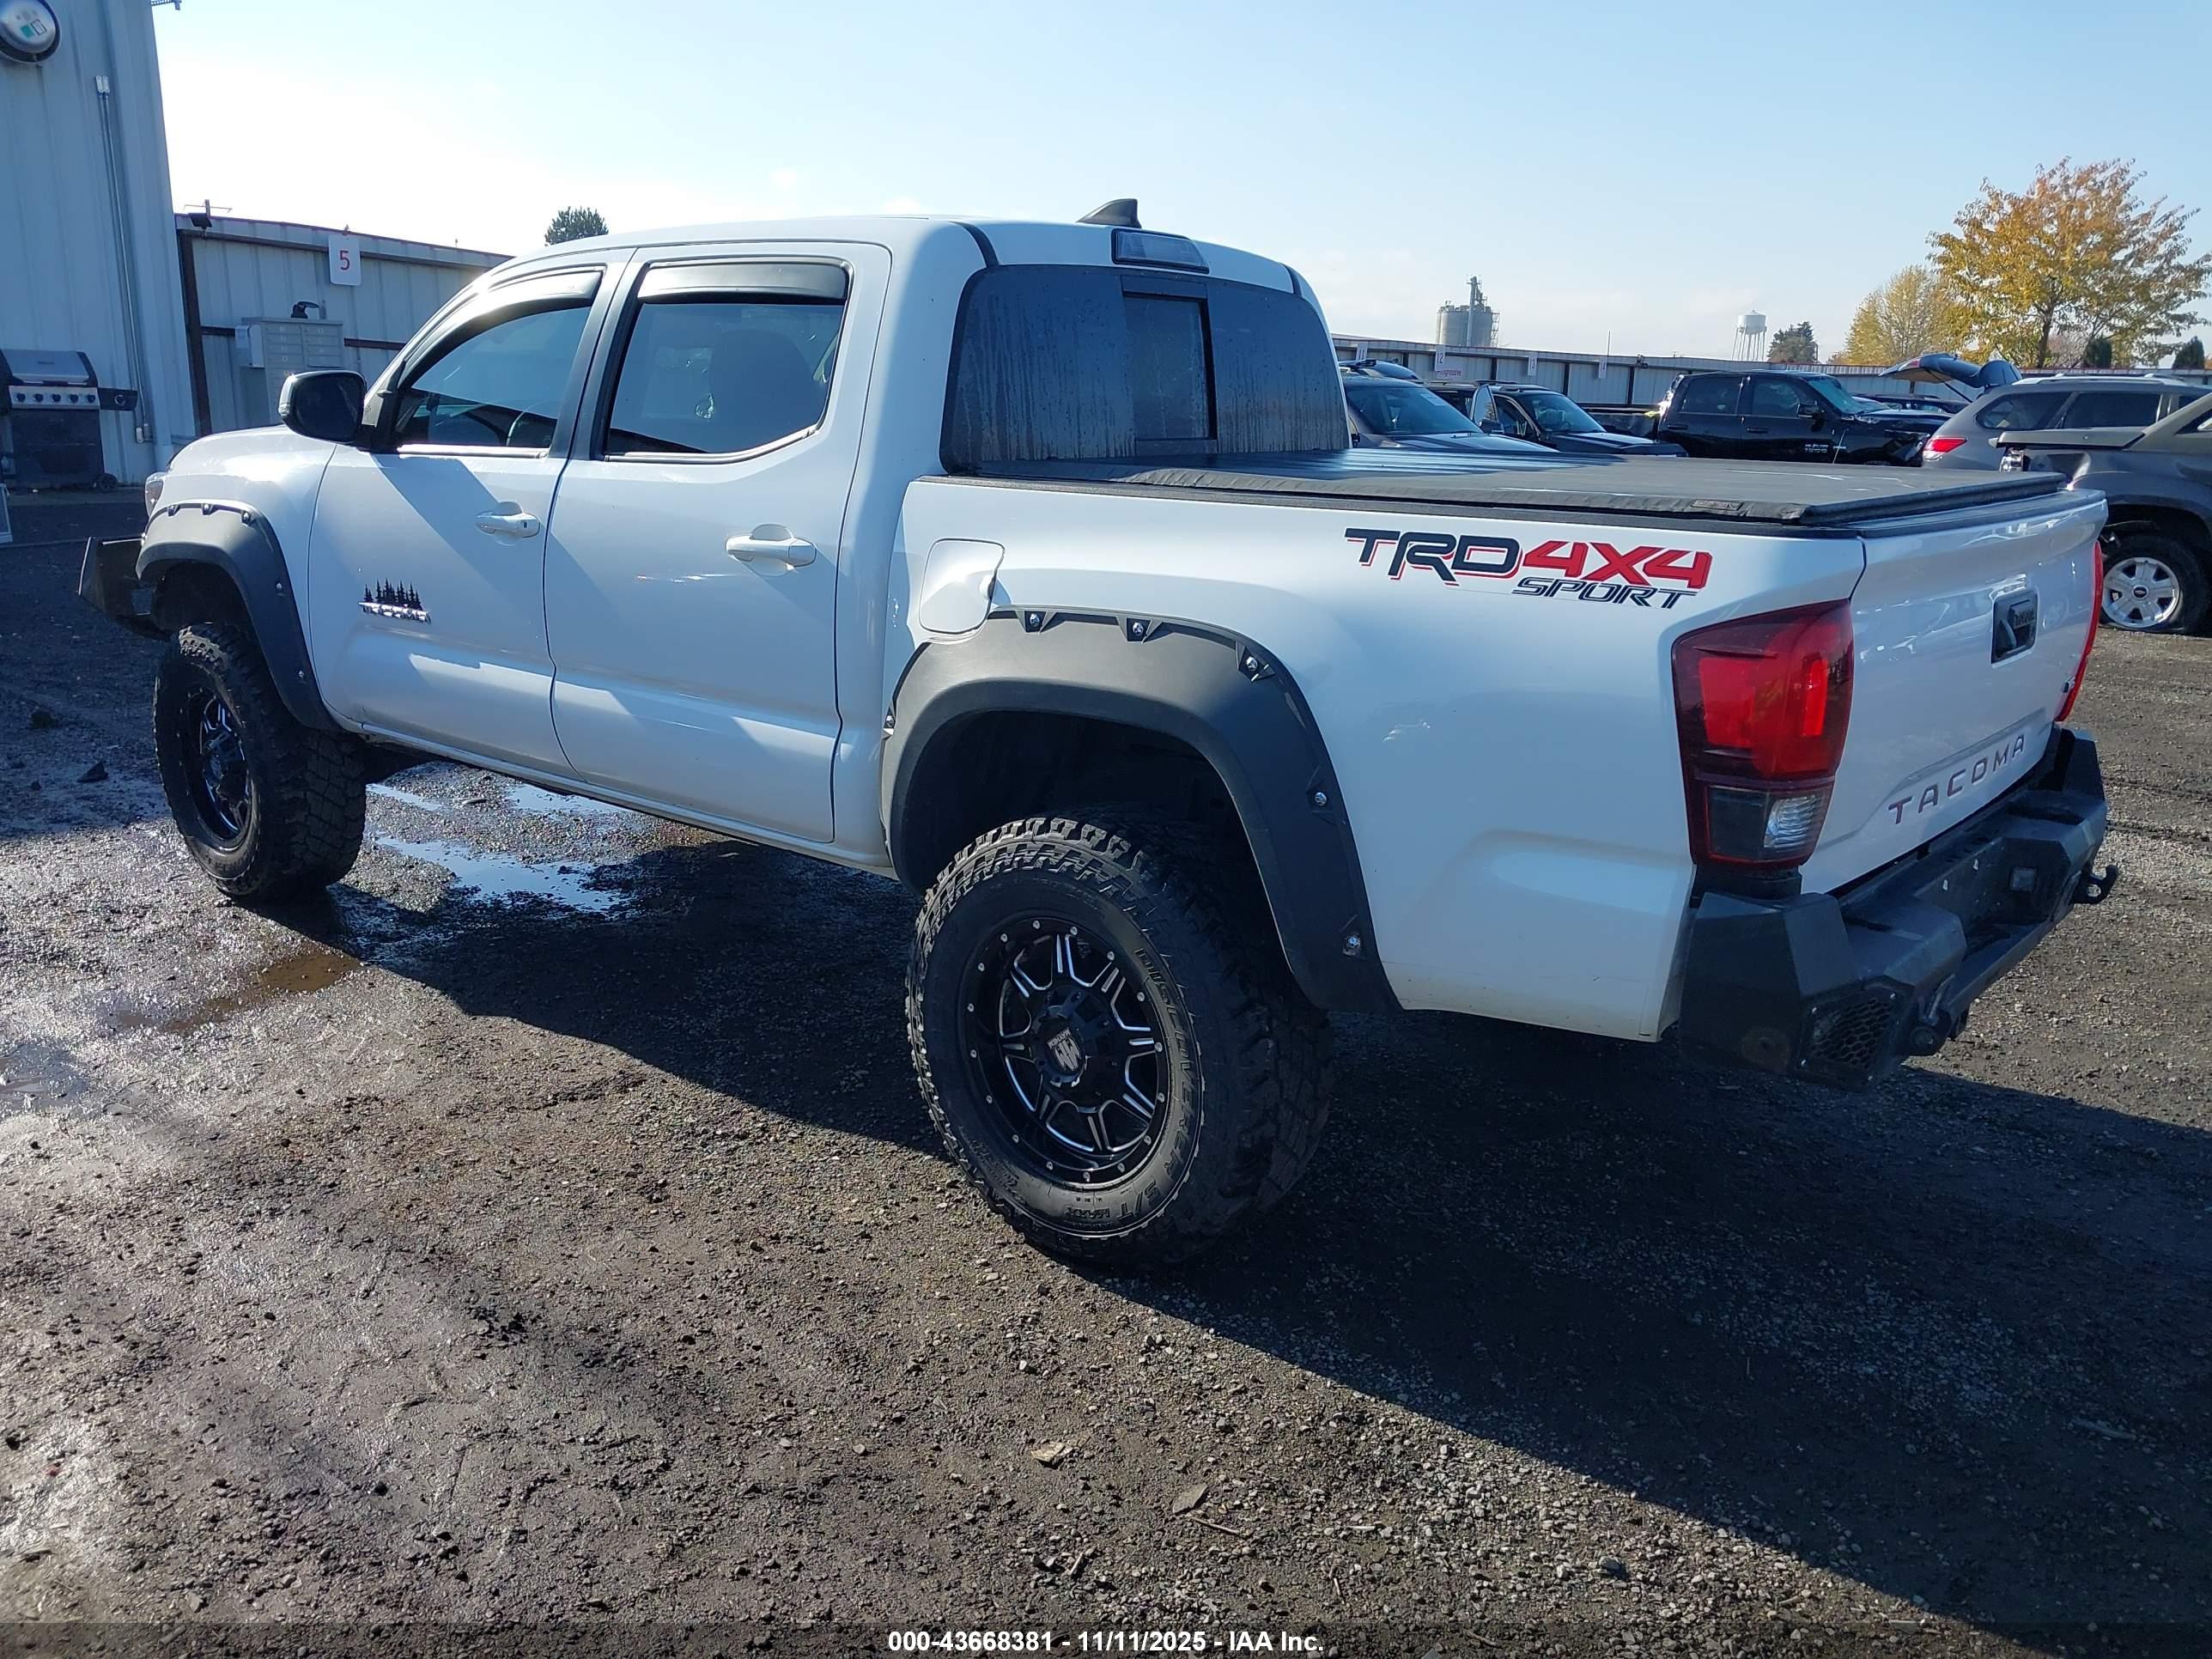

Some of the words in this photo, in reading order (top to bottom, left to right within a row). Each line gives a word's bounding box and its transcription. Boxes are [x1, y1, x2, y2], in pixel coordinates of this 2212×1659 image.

[339, 250, 350, 270] 5
[1436, 351, 1444, 364] 12
[1344, 527, 1523, 586] TRD
[1510, 576, 1698, 610] SPORT
[1887, 733, 2025, 825] TACOMA
